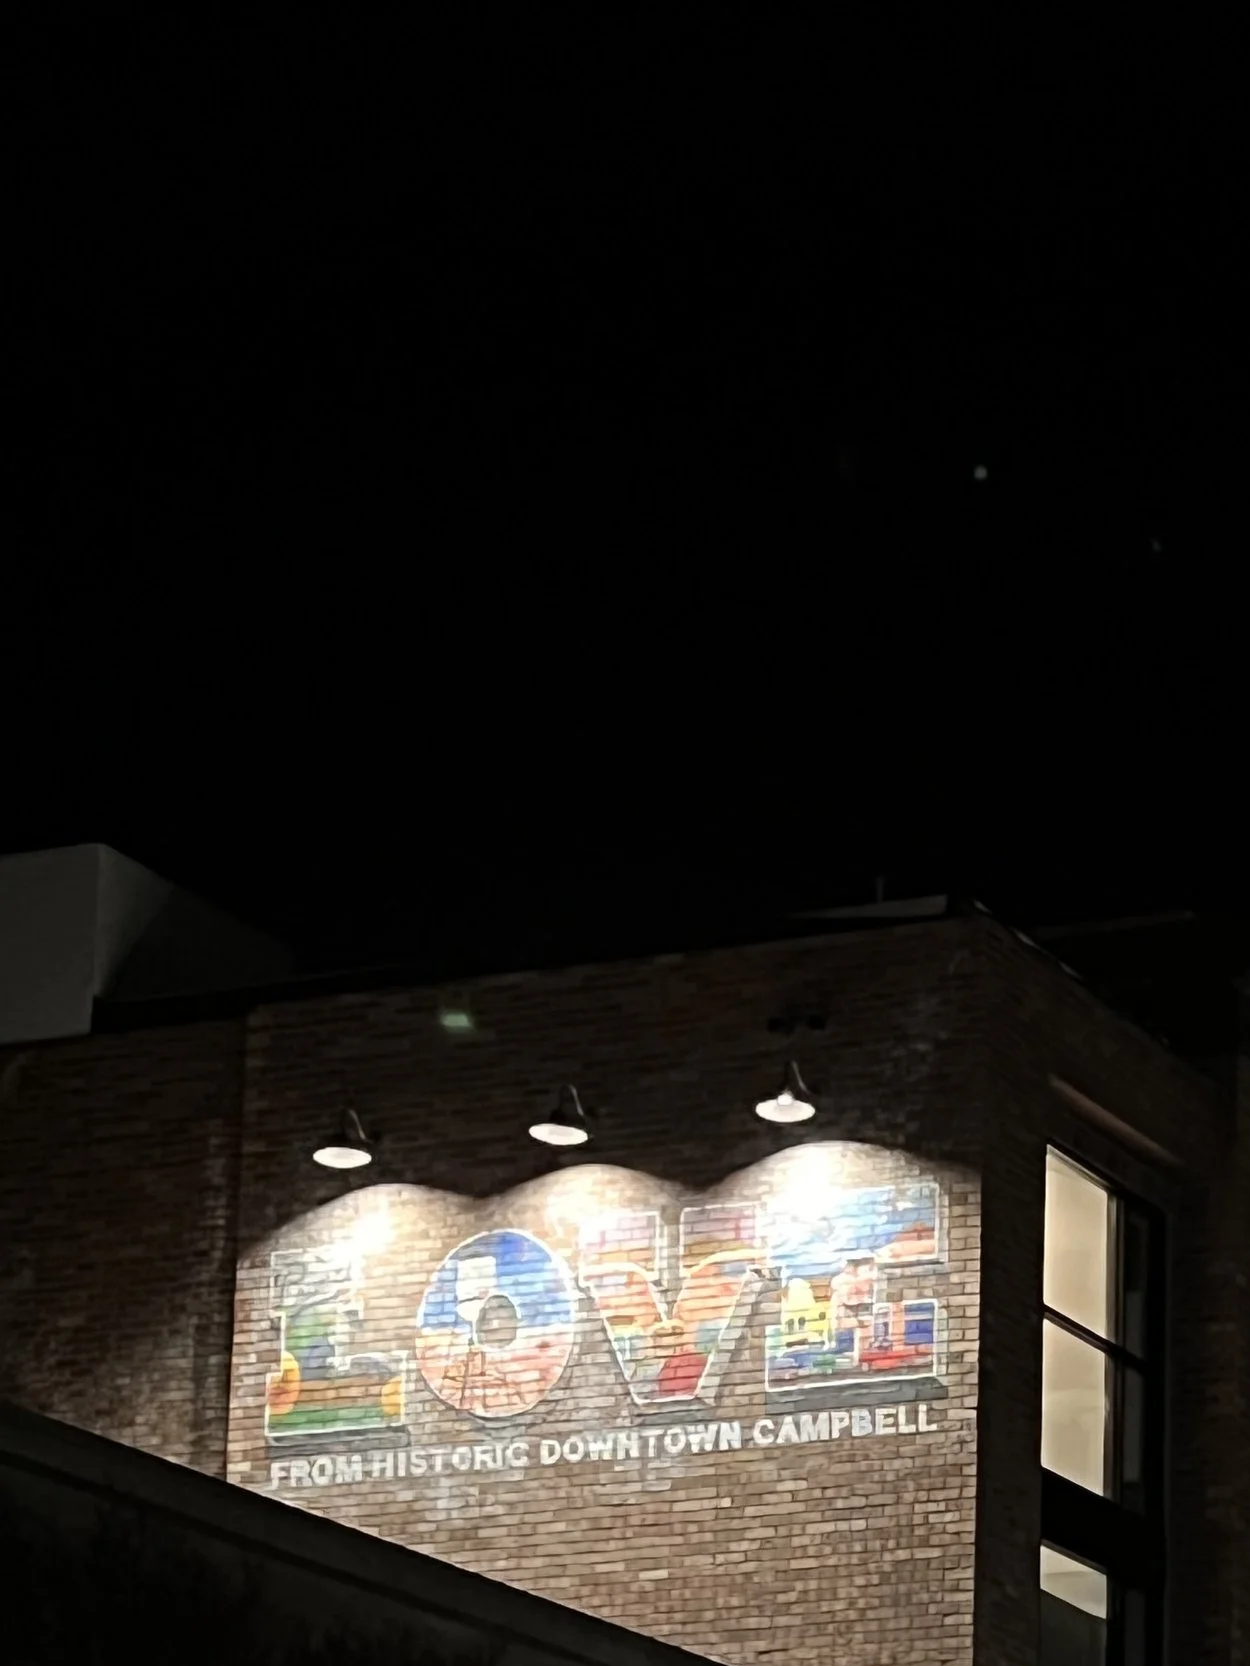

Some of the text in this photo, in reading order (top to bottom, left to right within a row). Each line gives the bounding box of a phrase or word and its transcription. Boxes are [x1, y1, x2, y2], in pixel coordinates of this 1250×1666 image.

[264, 1183, 945, 1441] LOVE
[270, 1403, 939, 1489] FROM HISTORIC DOWNTOWN CAMPBELL
